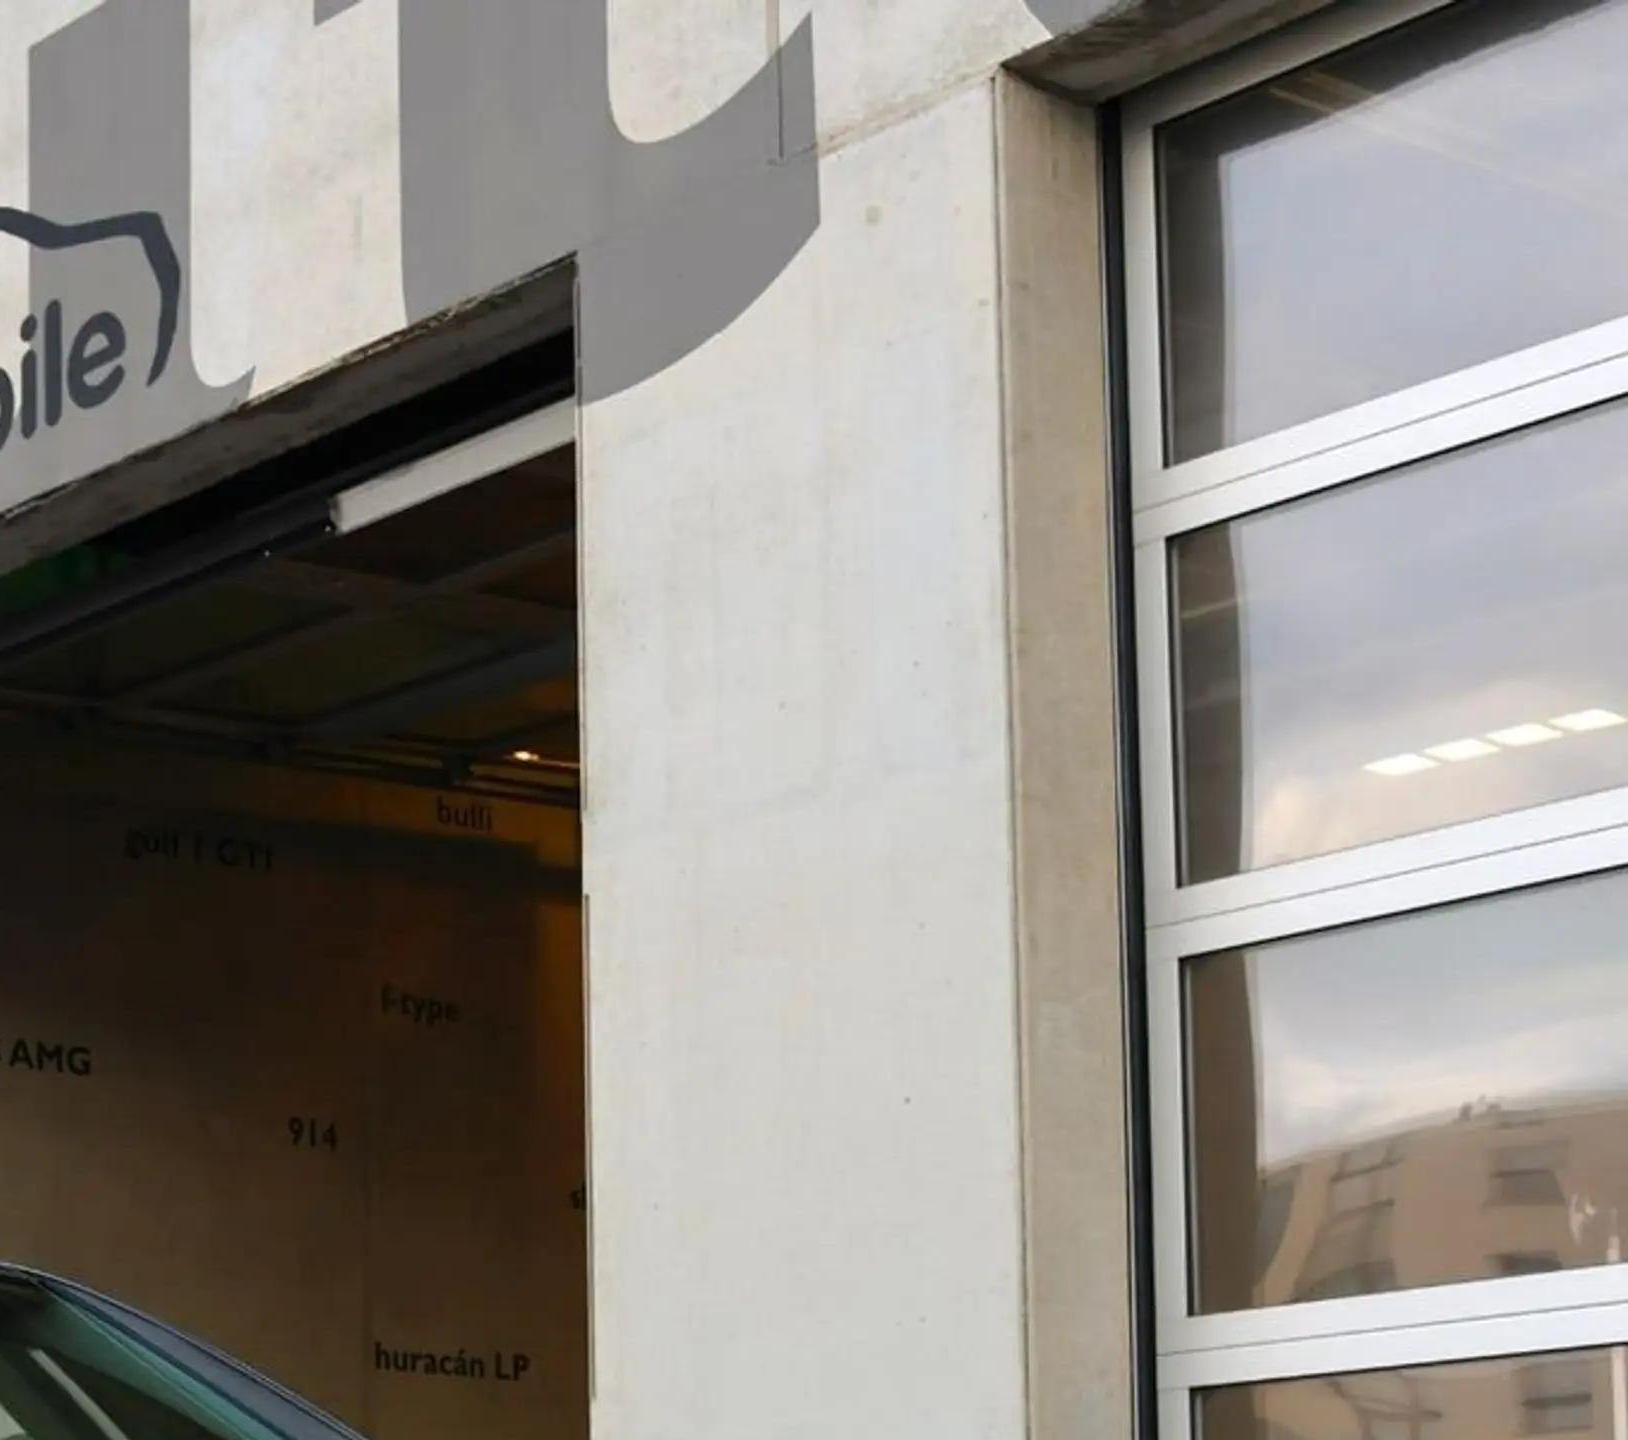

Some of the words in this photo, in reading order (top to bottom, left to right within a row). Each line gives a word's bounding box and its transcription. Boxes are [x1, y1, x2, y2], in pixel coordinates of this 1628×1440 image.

[436, 795, 493, 833] bulli
[217, 837, 274, 871] GTI
[9, 1037, 92, 1076] AMG
[288, 1116, 338, 1151] 914
[375, 1341, 485, 1379] huracán
[494, 1351, 530, 1381] LP
